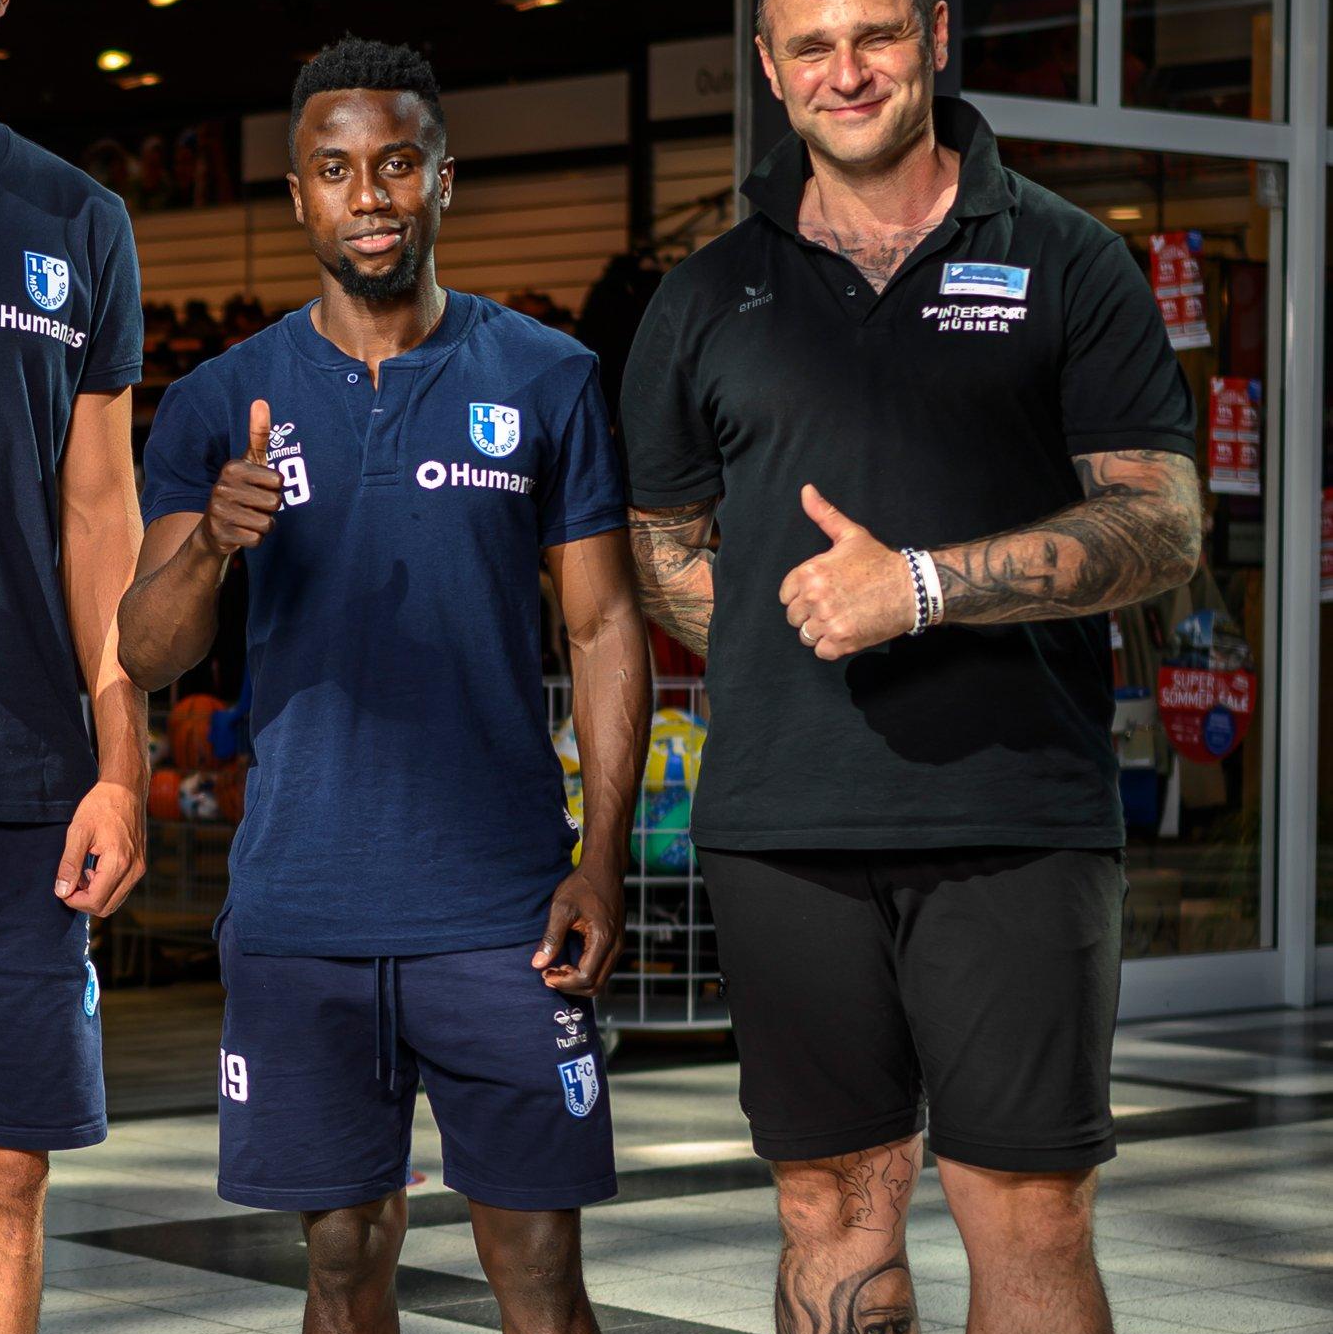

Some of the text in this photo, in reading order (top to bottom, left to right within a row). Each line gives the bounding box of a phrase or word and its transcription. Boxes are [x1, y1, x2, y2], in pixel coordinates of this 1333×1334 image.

[28, 274, 67, 308] MAGDEBURG
[739, 292, 773, 313] erima
[0, 304, 87, 349] Humanas
[936, 304, 1028, 321] INTERSPORT
[938, 317, 1010, 334] HÜBNER
[266, 441, 301, 461] ummel
[473, 423, 517, 455] MAGDEBURG
[450, 463, 536, 494] Human
[1172, 669, 1215, 690] SUPER
[1160, 685, 1250, 713] SOMMER SALE
[220, 1047, 248, 1102] 19
